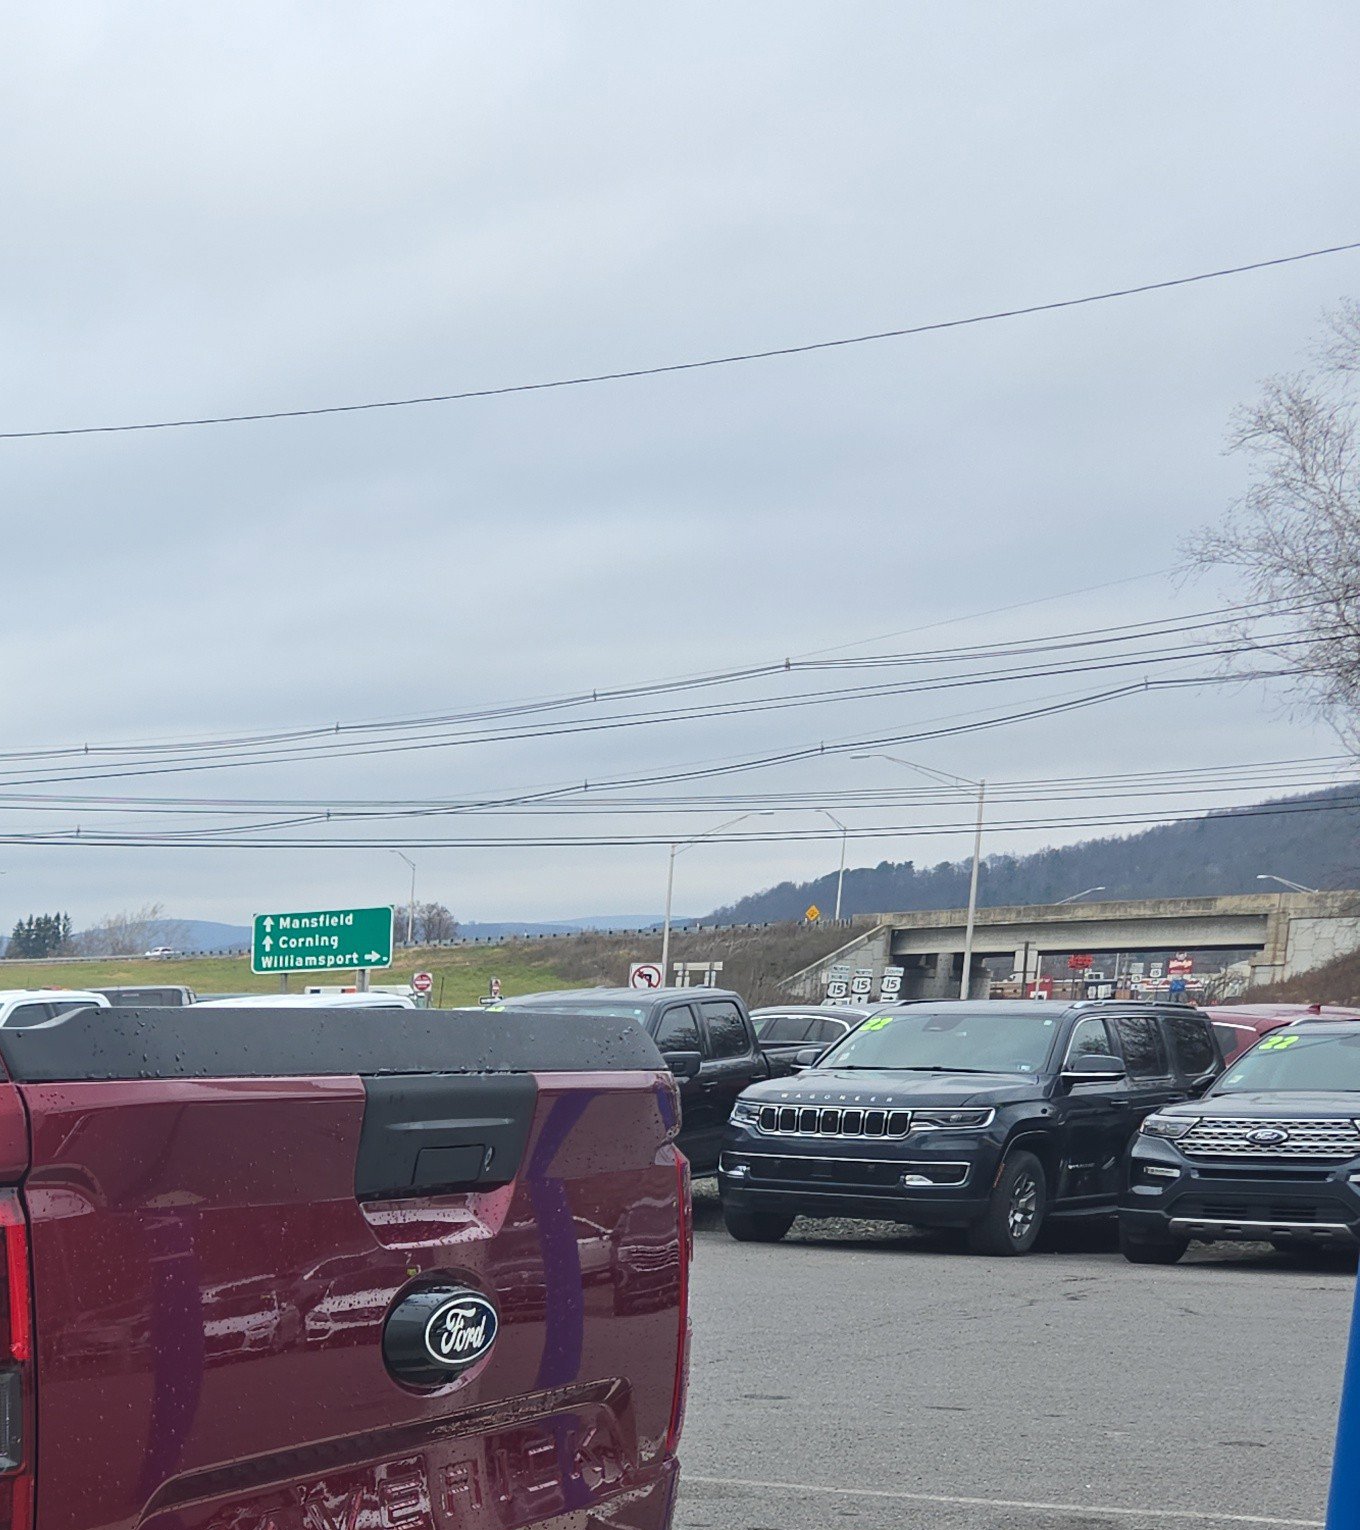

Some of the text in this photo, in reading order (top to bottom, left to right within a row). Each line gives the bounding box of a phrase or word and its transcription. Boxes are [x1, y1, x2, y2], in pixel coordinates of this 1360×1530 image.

[279, 913, 353, 929] Mansfield
[279, 933, 339, 949] Corning
[261, 952, 359, 969] Williamsport
[833, 985, 844, 994] 15
[856, 980, 868, 989] 15
[887, 979, 897, 989] 15
[440, 1307, 487, 1354] Ford
